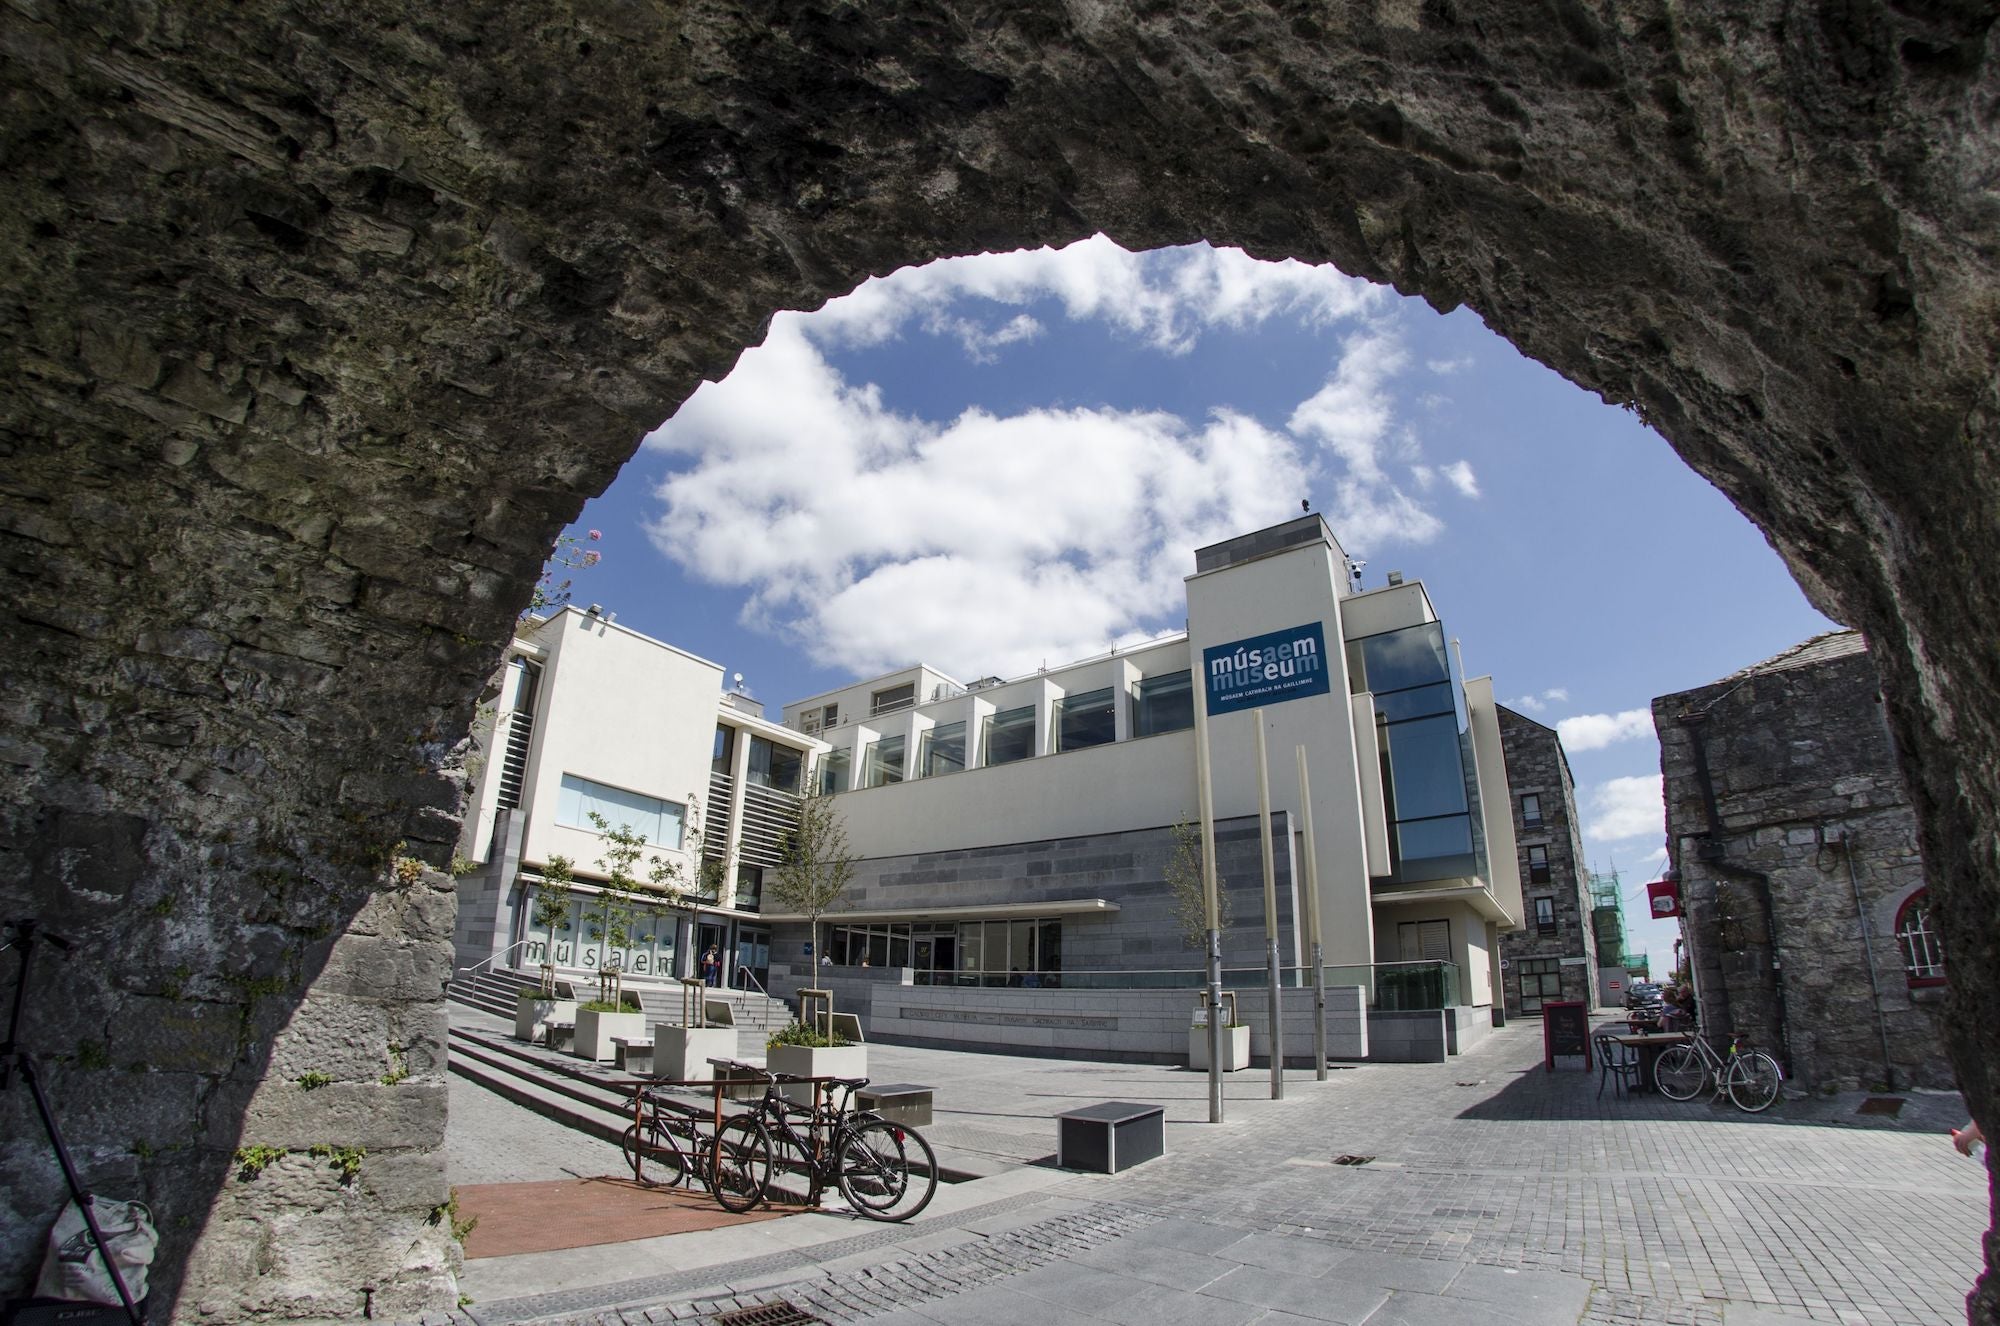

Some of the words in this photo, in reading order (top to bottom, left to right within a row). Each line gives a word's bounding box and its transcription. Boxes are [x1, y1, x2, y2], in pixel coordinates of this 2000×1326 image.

[1211, 637, 1316, 676] músaem
[1213, 653, 1319, 691] museum
[1274, 683, 1282, 691] NA
[1283, 677, 1313, 689] GAILLIMHE
[525, 937, 675, 973] músaem
